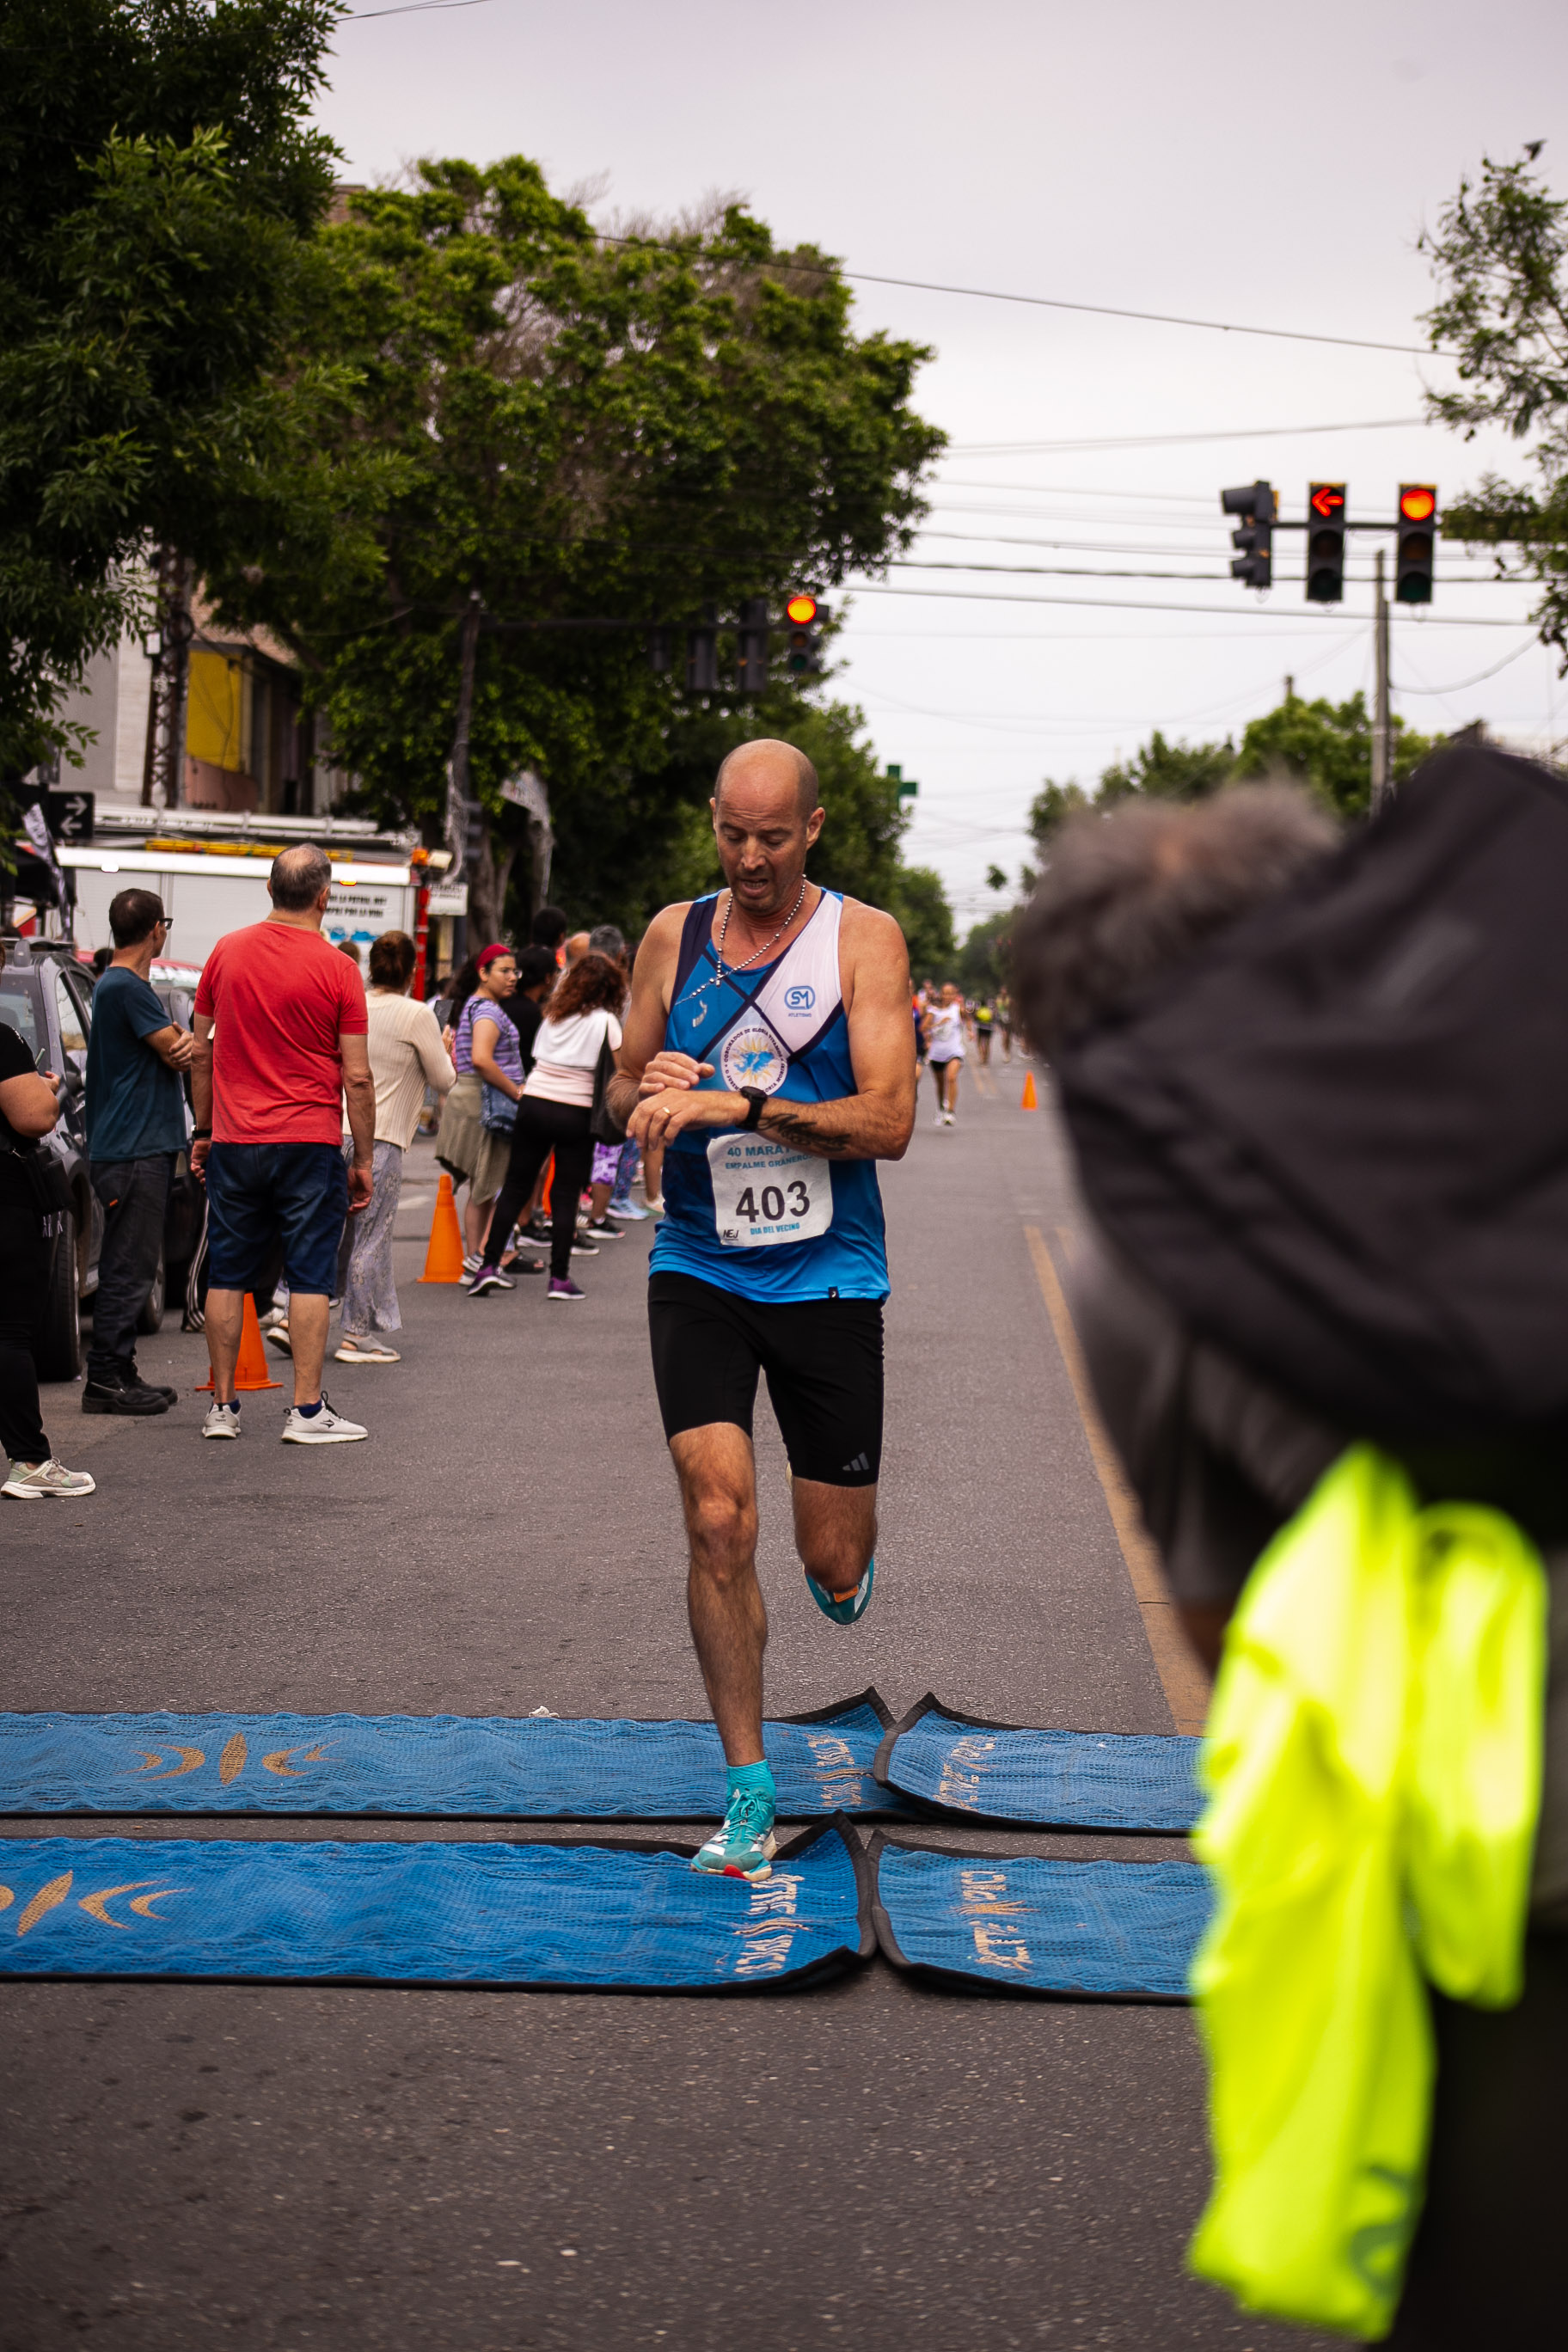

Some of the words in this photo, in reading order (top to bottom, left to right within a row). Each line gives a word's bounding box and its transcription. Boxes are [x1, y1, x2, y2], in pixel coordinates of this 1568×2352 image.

[791, 990, 810, 1009] SM
[727, 1147, 741, 1156] 40
[736, 1180, 811, 1222] 403
[763, 1226, 775, 1234] DEL
[775, 1222, 800, 1233] VECINO
